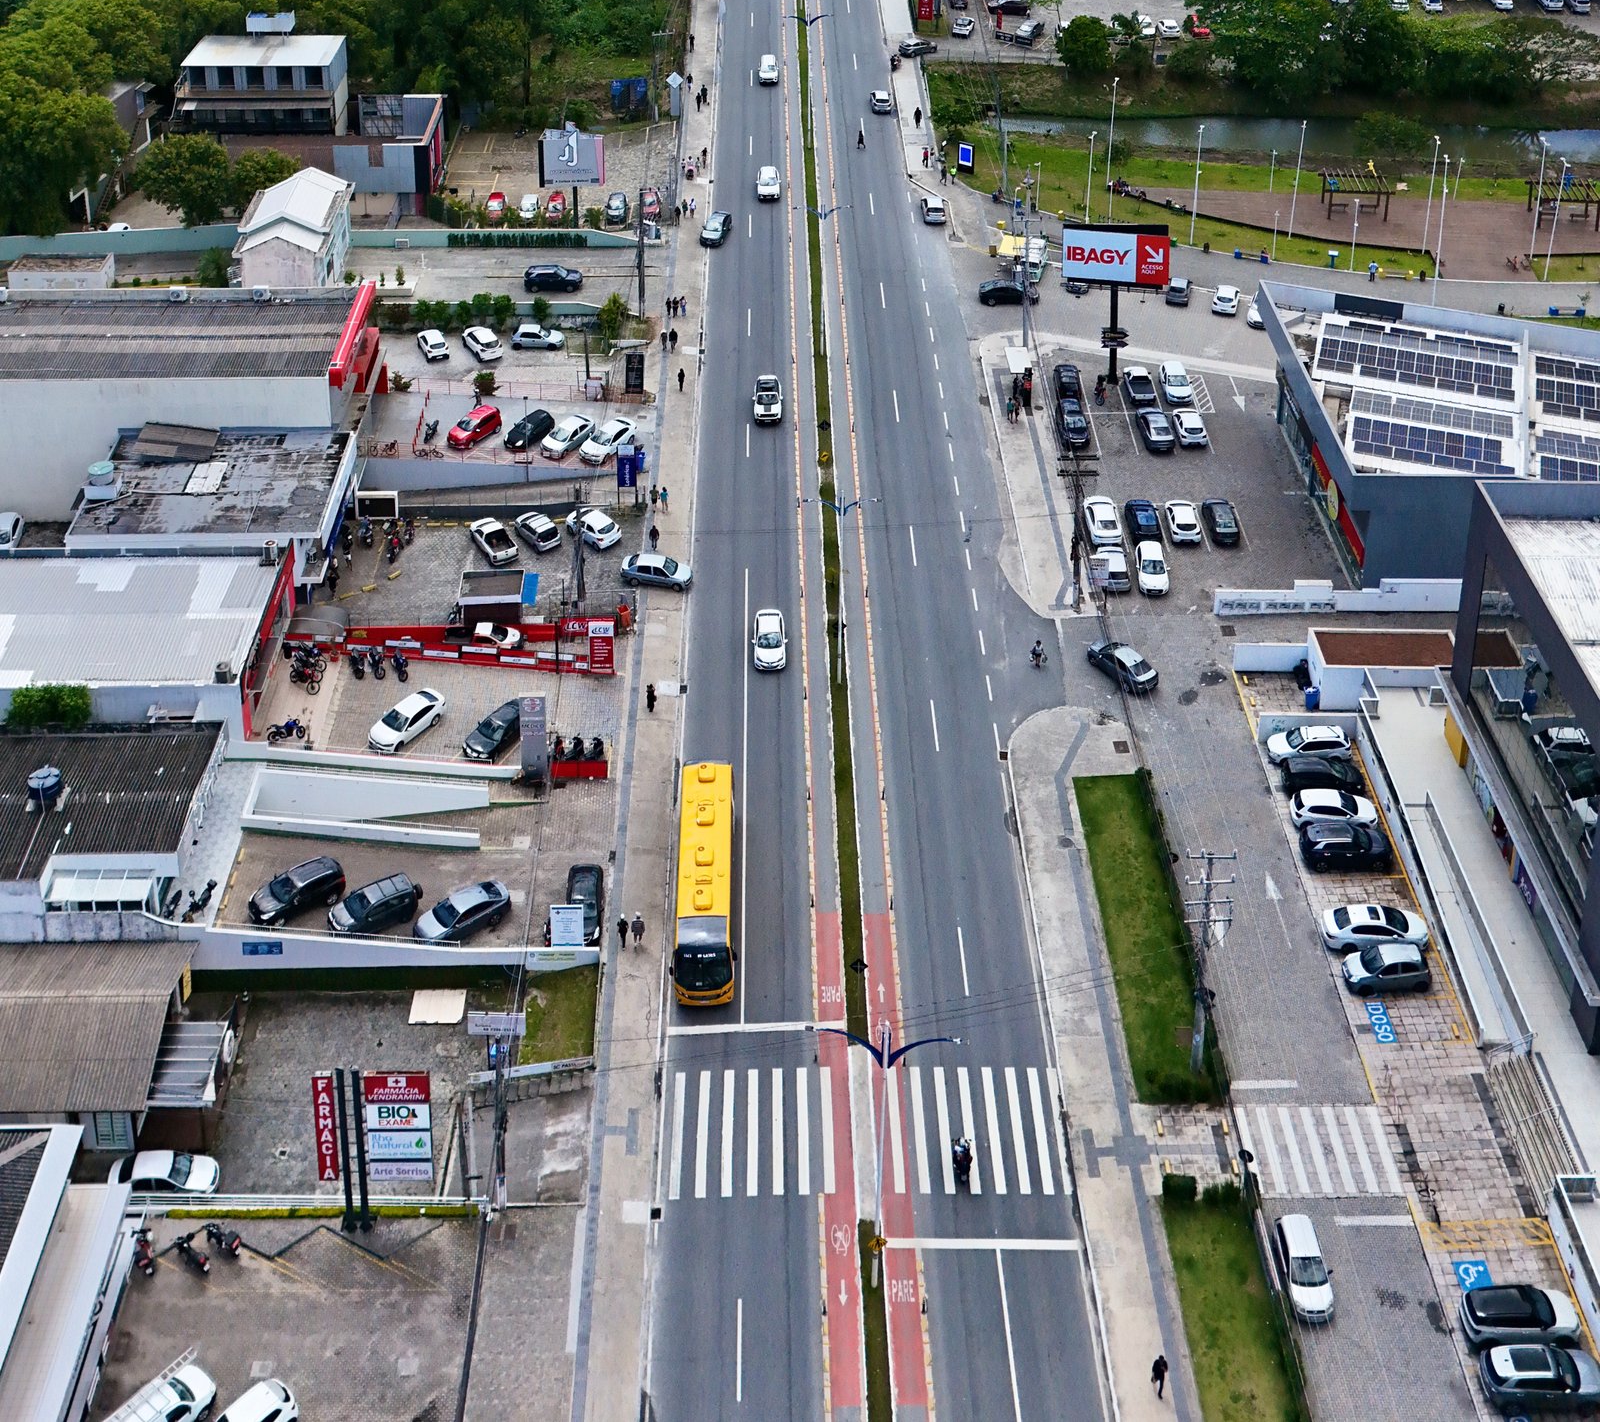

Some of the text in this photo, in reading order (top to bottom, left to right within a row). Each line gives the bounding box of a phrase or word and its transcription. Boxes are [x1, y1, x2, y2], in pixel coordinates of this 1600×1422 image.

[1066, 246, 1133, 265] IBAGY
[565, 621, 587, 631] LCW
[592, 626, 611, 635] LCW
[821, 985, 841, 1003] PARE
[1366, 1002, 1394, 1042] IDOSO
[373, 1086, 419, 1095] FARMÁCIA
[377, 1106, 410, 1119] BIO
[378, 1118, 415, 1126] EXAME
[317, 1079, 336, 1180] FARMÁCIA
[374, 1167, 429, 1175] Arte Sorriso
[891, 1279, 915, 1303] PARE
